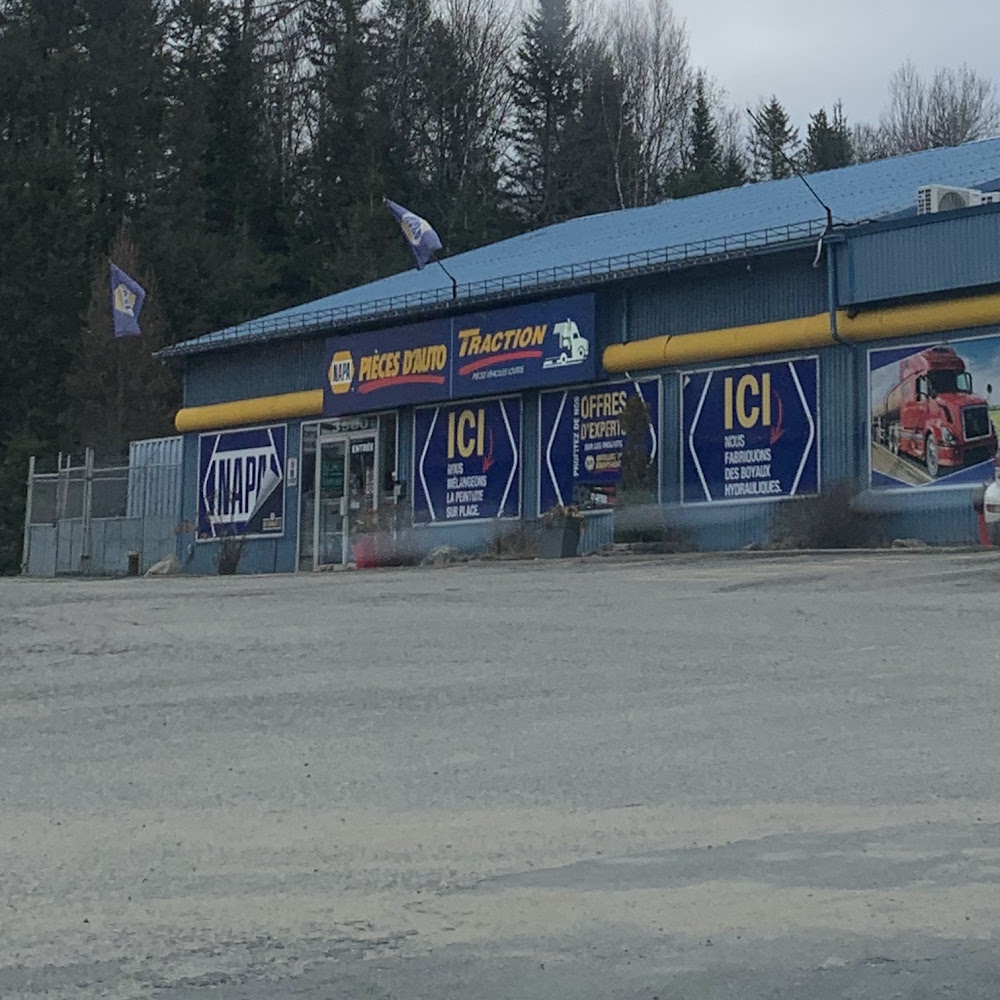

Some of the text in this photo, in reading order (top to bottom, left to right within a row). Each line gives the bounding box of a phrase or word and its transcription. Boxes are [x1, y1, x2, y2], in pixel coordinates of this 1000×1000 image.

[459, 324, 547, 357] TRACTION
[402, 344, 447, 375] D'AUTO
[581, 391, 627, 419] OFFRES
[724, 372, 771, 430] ICI
[447, 408, 486, 459] ICI
[724, 434, 745, 448] NOUS
[724, 448, 771, 464] FABRIQUONS
[724, 465, 771, 480] DES BOYAUX
[446, 491, 454, 504] LA
